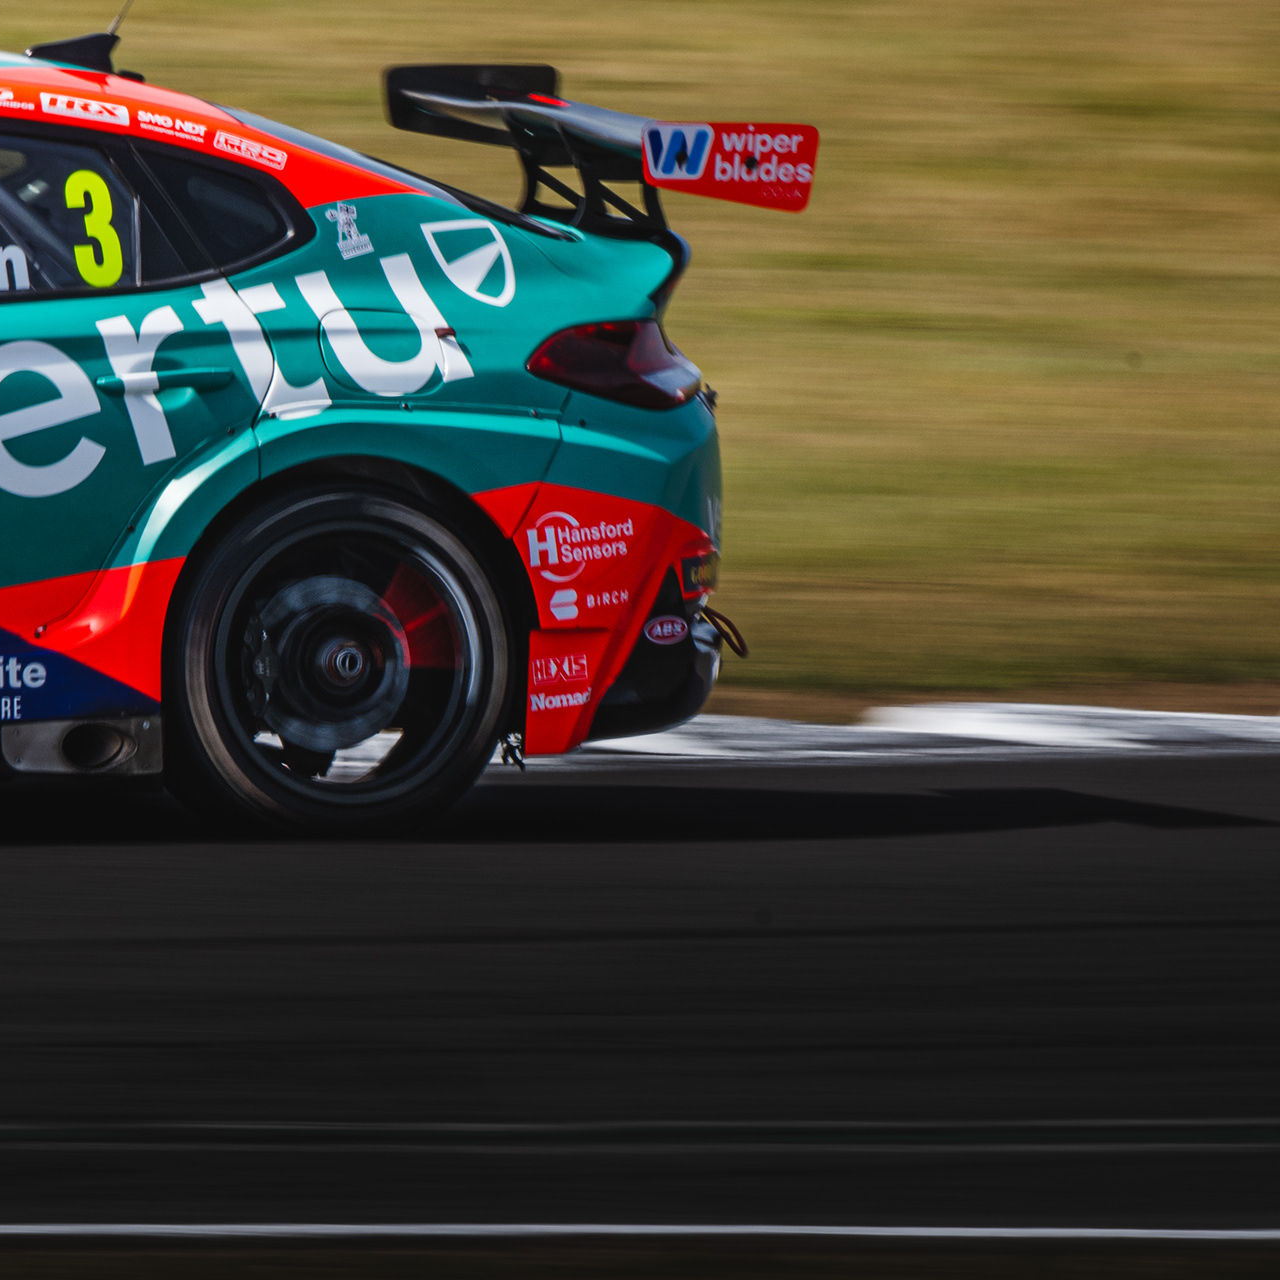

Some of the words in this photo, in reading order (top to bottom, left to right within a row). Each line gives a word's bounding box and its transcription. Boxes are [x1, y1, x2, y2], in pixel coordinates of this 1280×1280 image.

[175, 118, 207, 137] NDT
[721, 124, 803, 160] wiper
[65, 170, 123, 287] 3
[558, 518, 634, 545] Hansford
[561, 540, 628, 563] Sensors
[586, 589, 630, 609] BIRCH
[532, 654, 588, 686] HEXIS
